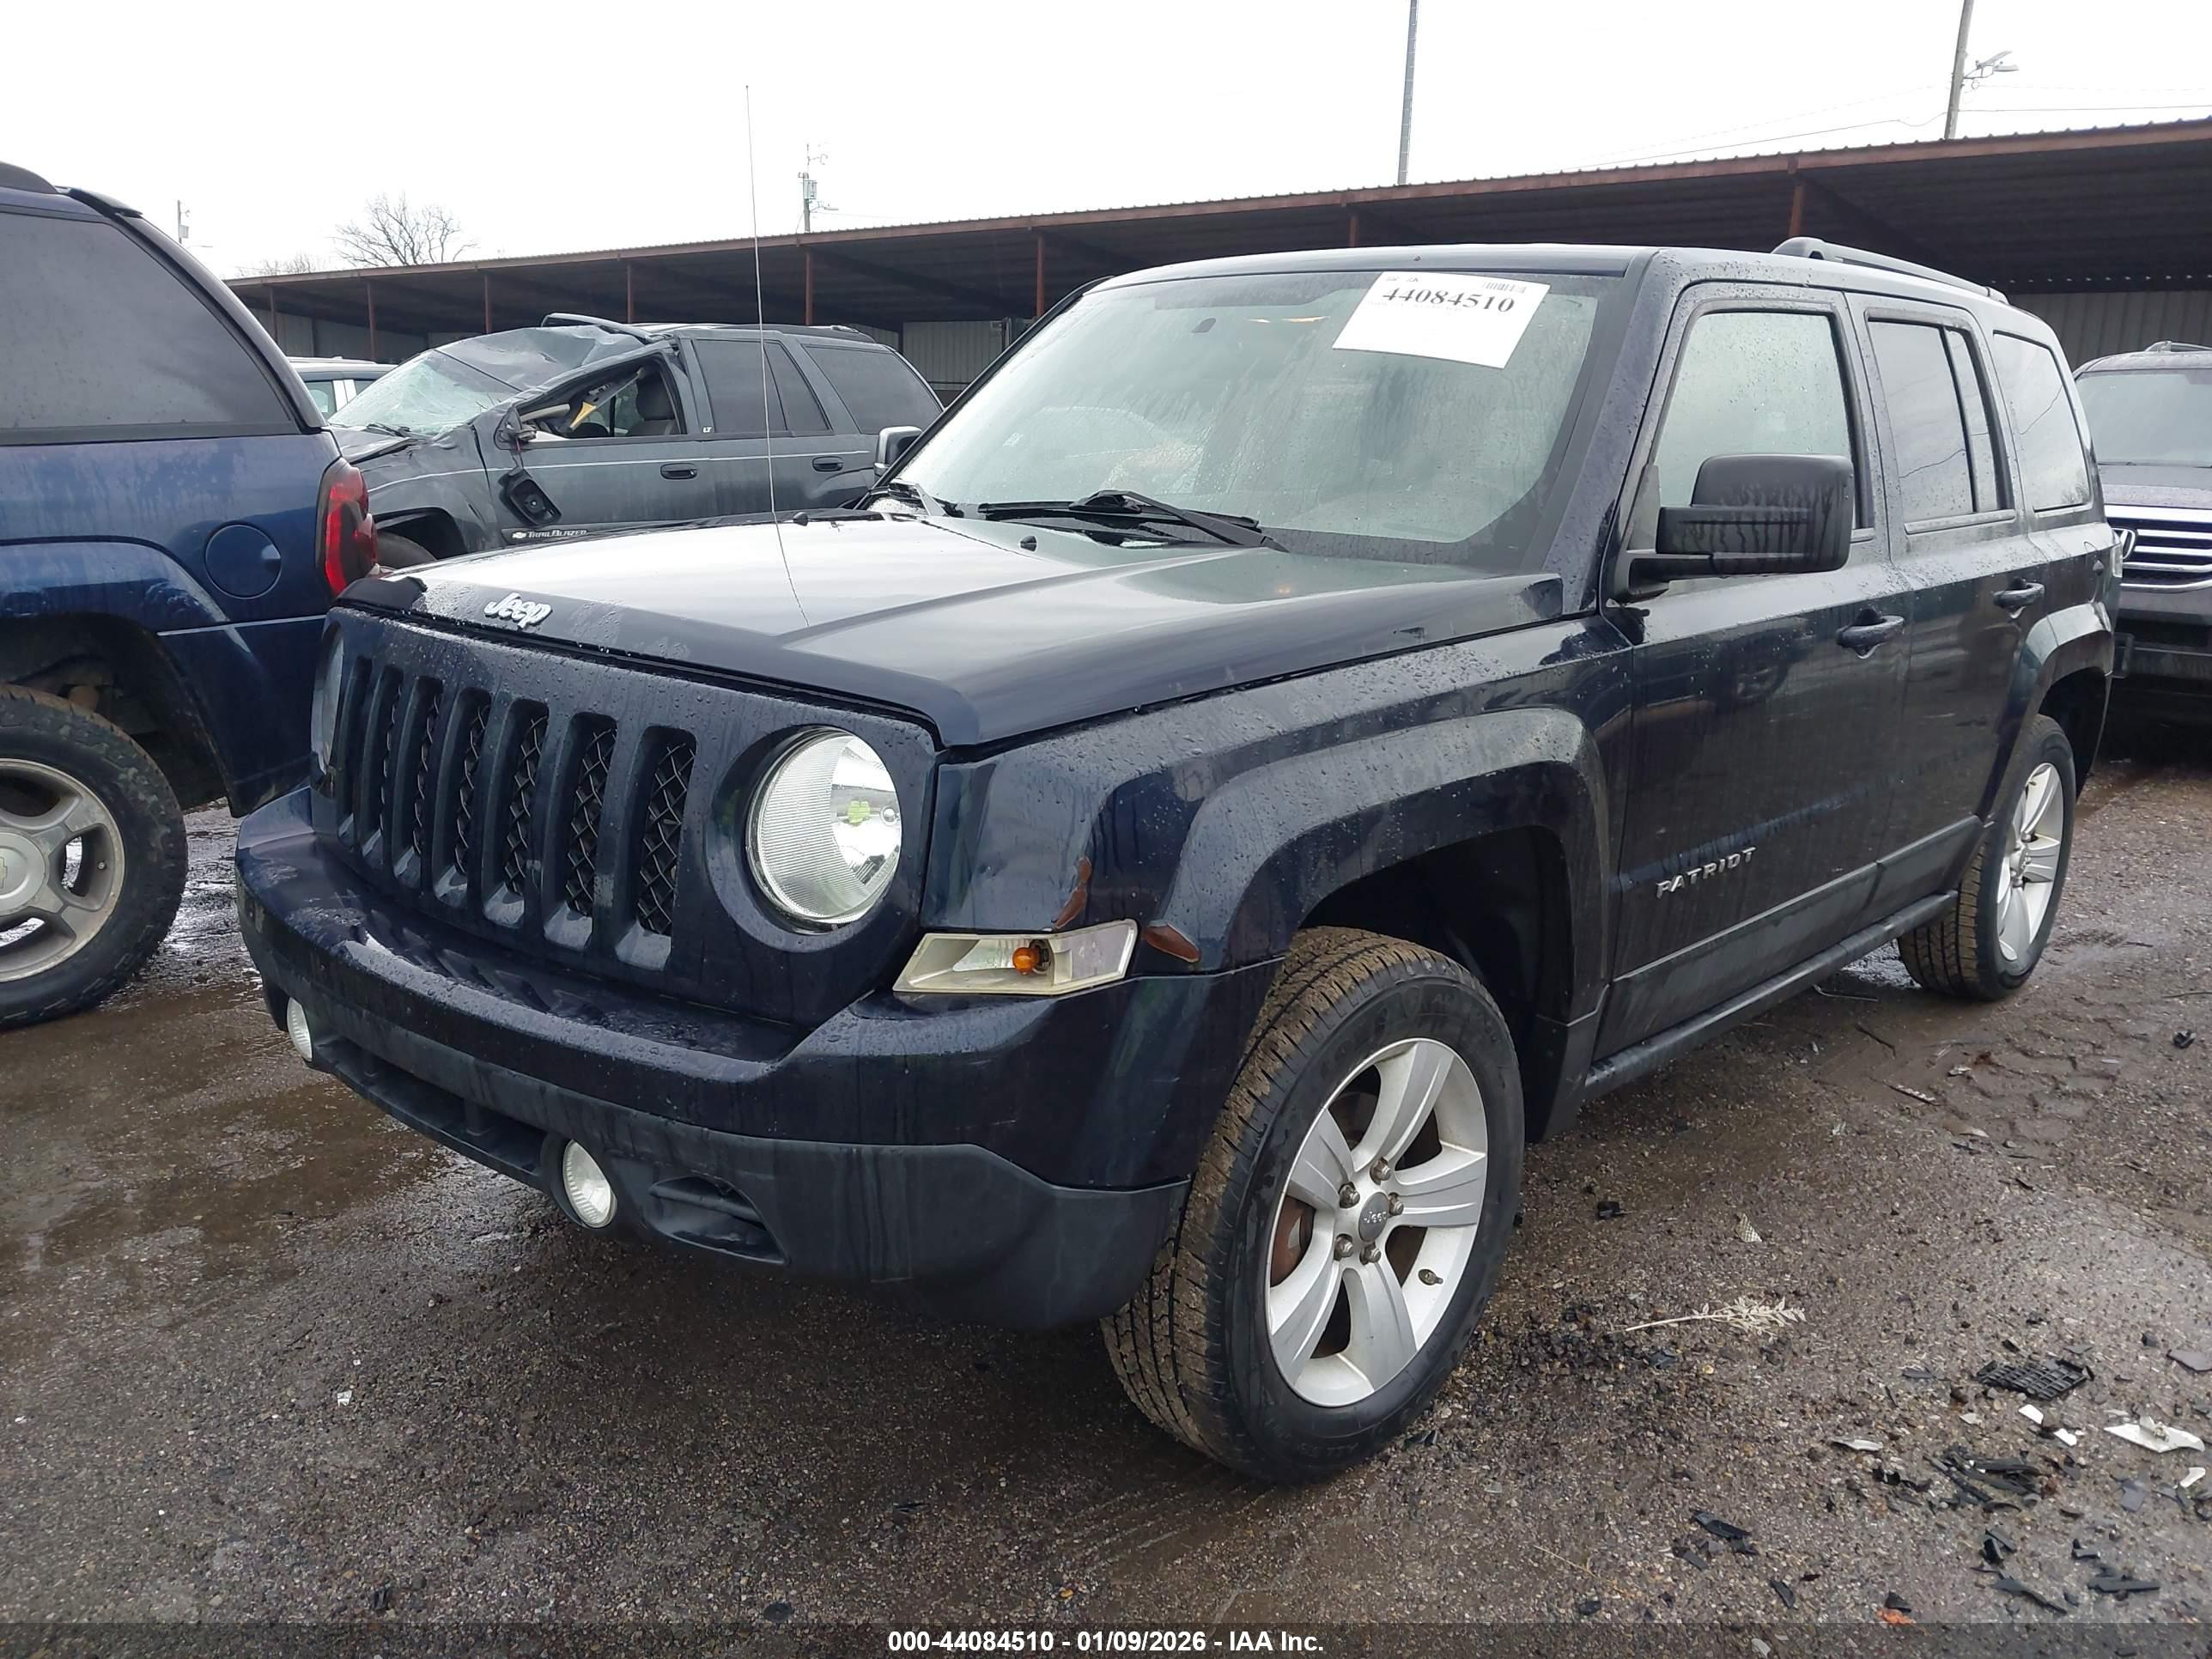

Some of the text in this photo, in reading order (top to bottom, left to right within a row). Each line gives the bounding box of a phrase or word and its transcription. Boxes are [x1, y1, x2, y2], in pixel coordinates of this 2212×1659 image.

[1382, 287, 1515, 313] 44084510
[483, 592, 552, 629] Jeep
[1656, 847, 1757, 899] PATRIOT
